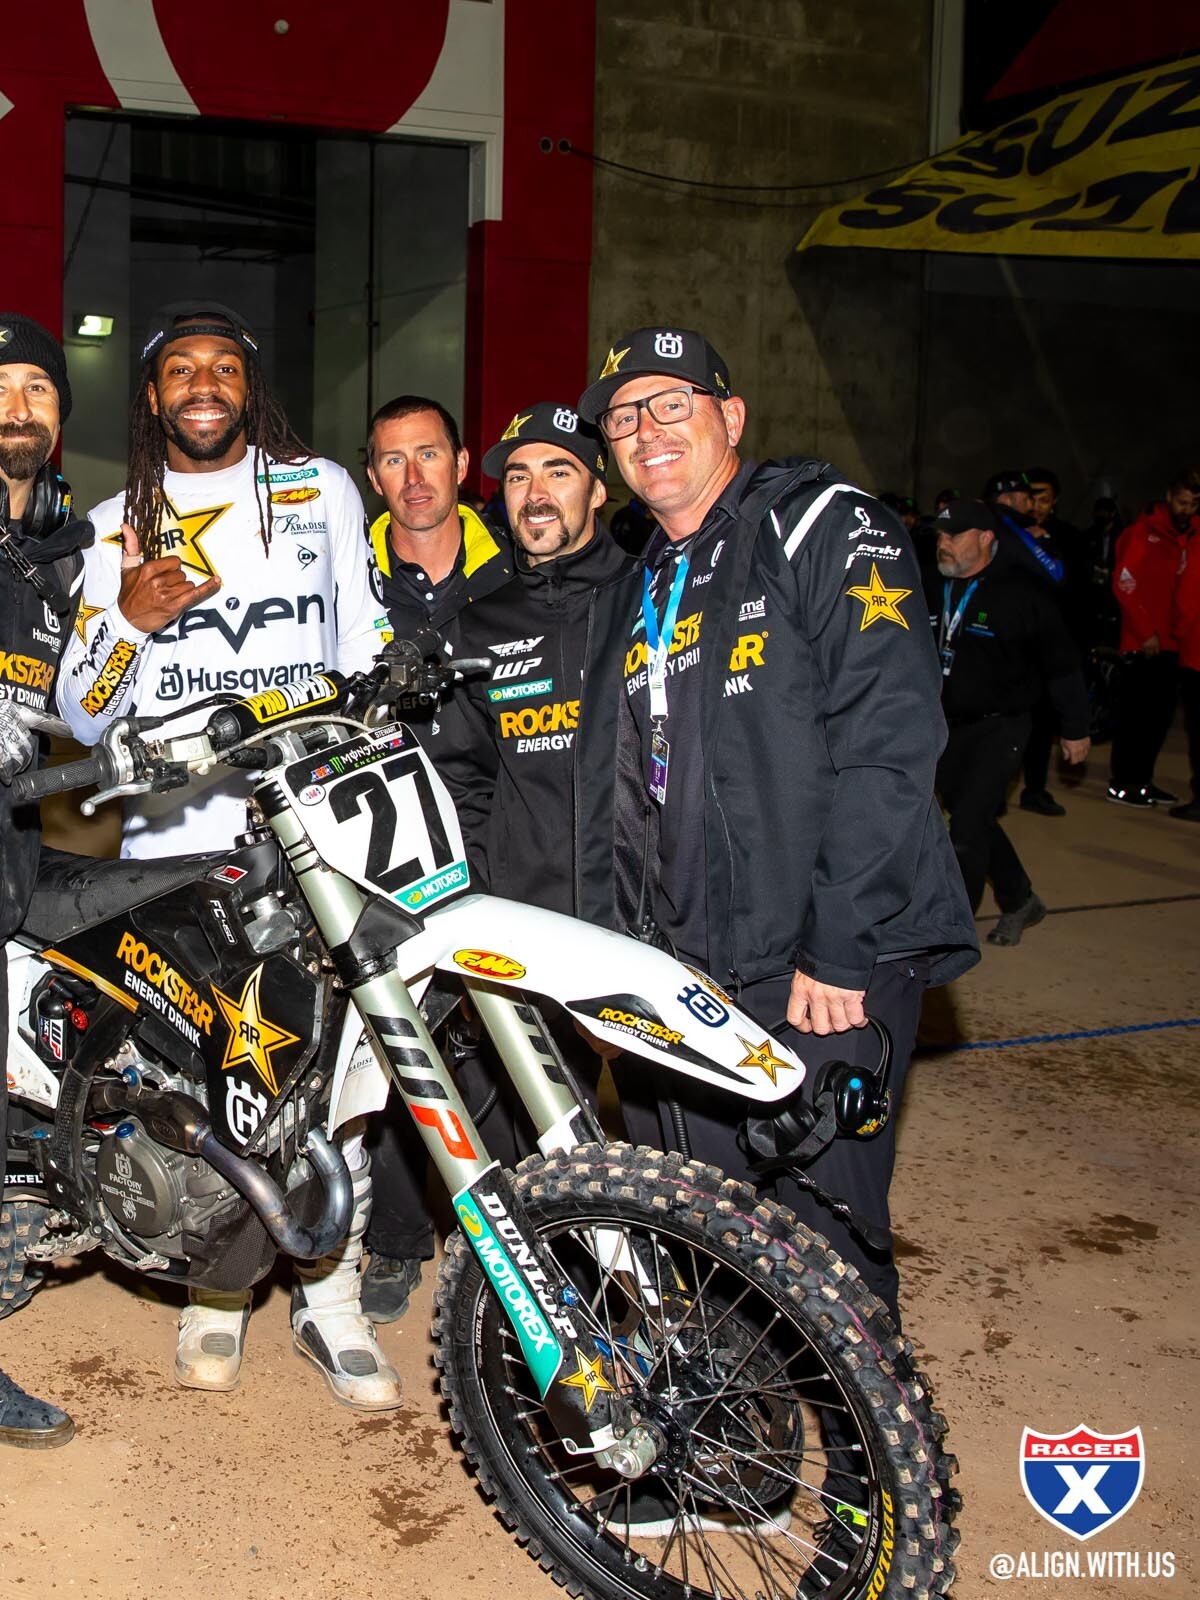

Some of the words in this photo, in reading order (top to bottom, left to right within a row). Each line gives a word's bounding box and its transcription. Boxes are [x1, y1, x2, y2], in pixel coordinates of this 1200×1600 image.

[81, 641, 137, 717] ROCKSTAR
[493, 657, 542, 680] WP
[17, 688, 46, 710] DRINK
[103, 682, 129, 717] ENERGY
[502, 681, 551, 699] MOTOREX
[374, 724, 398, 739] STEWART
[516, 733, 574, 753] ENERGY
[354, 752, 387, 768] ENERGY
[328, 751, 455, 894] 27
[420, 867, 466, 898] MOTOREX
[455, 951, 526, 975] FMF
[116, 931, 215, 1036] ROCKSTAR
[124, 970, 167, 1015] ENERGY
[168, 1005, 201, 1048] DRINK
[598, 1008, 684, 1045] ROCKSTAR
[603, 1020, 640, 1038] ENERGY
[640, 1032, 669, 1049] DRINK
[4, 1174, 43, 1184] EXCEL
[109, 1173, 142, 1190] FACTORY
[478, 1192, 578, 1339] DUNLOP
[475, 1238, 556, 1352] MOTOREX
